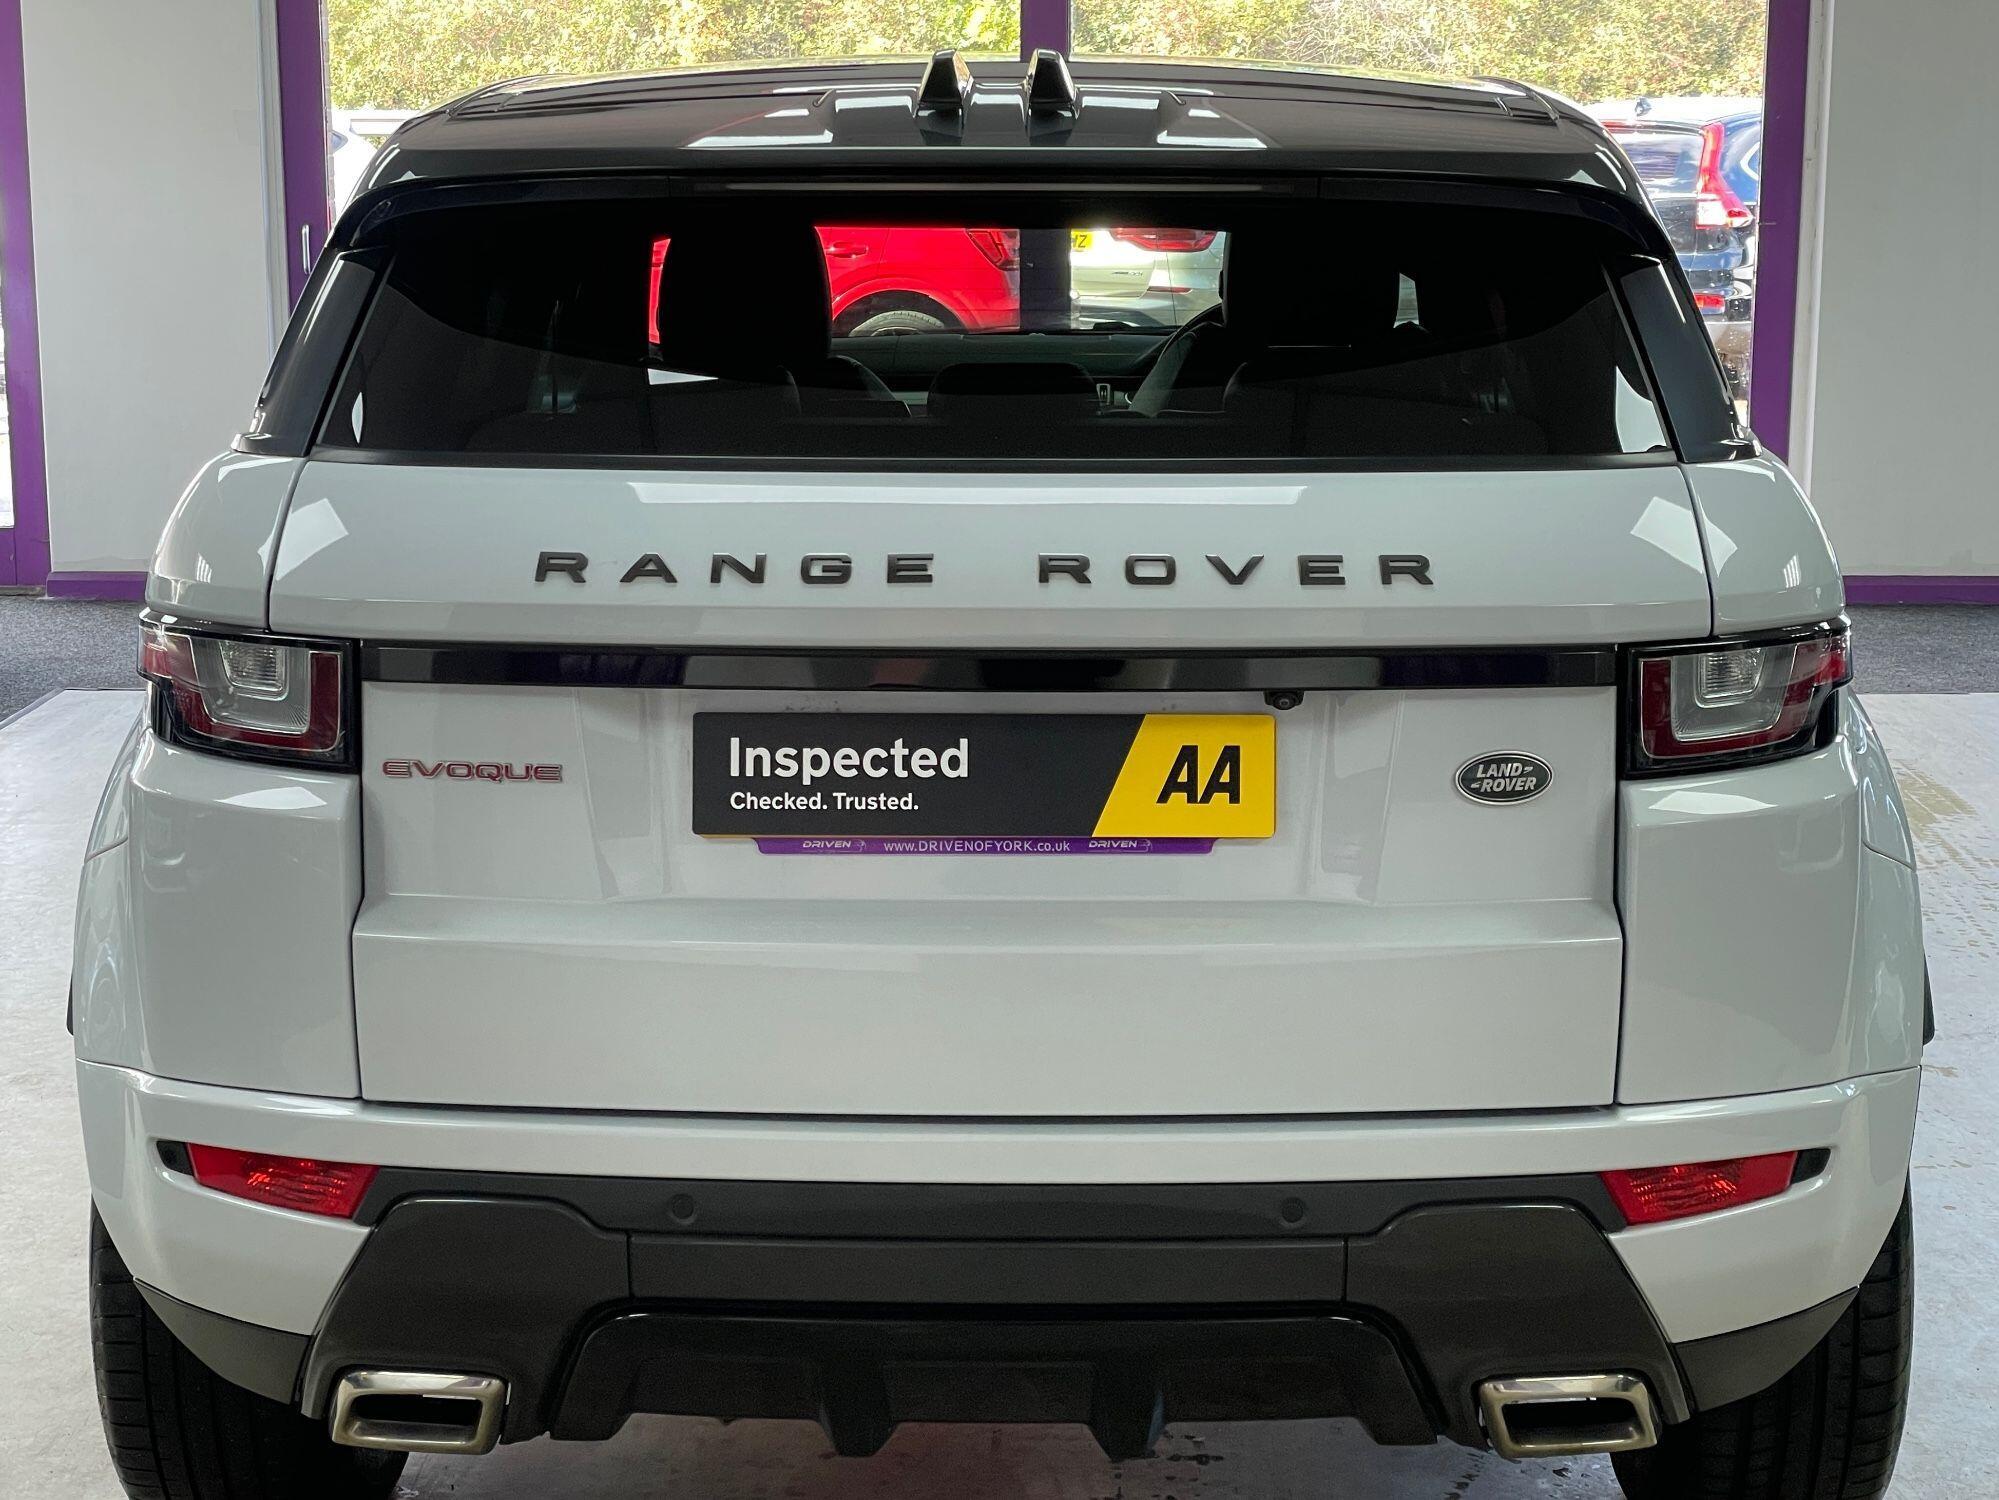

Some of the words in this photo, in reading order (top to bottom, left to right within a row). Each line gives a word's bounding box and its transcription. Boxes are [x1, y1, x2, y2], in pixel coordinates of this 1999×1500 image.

[535, 551, 934, 584] RANGE
[1038, 553, 1436, 586] ROVER
[382, 759, 562, 782] EVOQUE
[730, 737, 970, 785] Inspected
[1156, 745, 1241, 804] AA
[1480, 777, 1537, 792] ROVER
[729, 791, 827, 811] Checked.
[833, 792, 919, 811] Trusted.
[802, 840, 852, 849] DRIVEN
[883, 840, 1070, 853] www.DRIVENOFYORK.co.uk
[1088, 840, 1138, 849] DRIVEN
